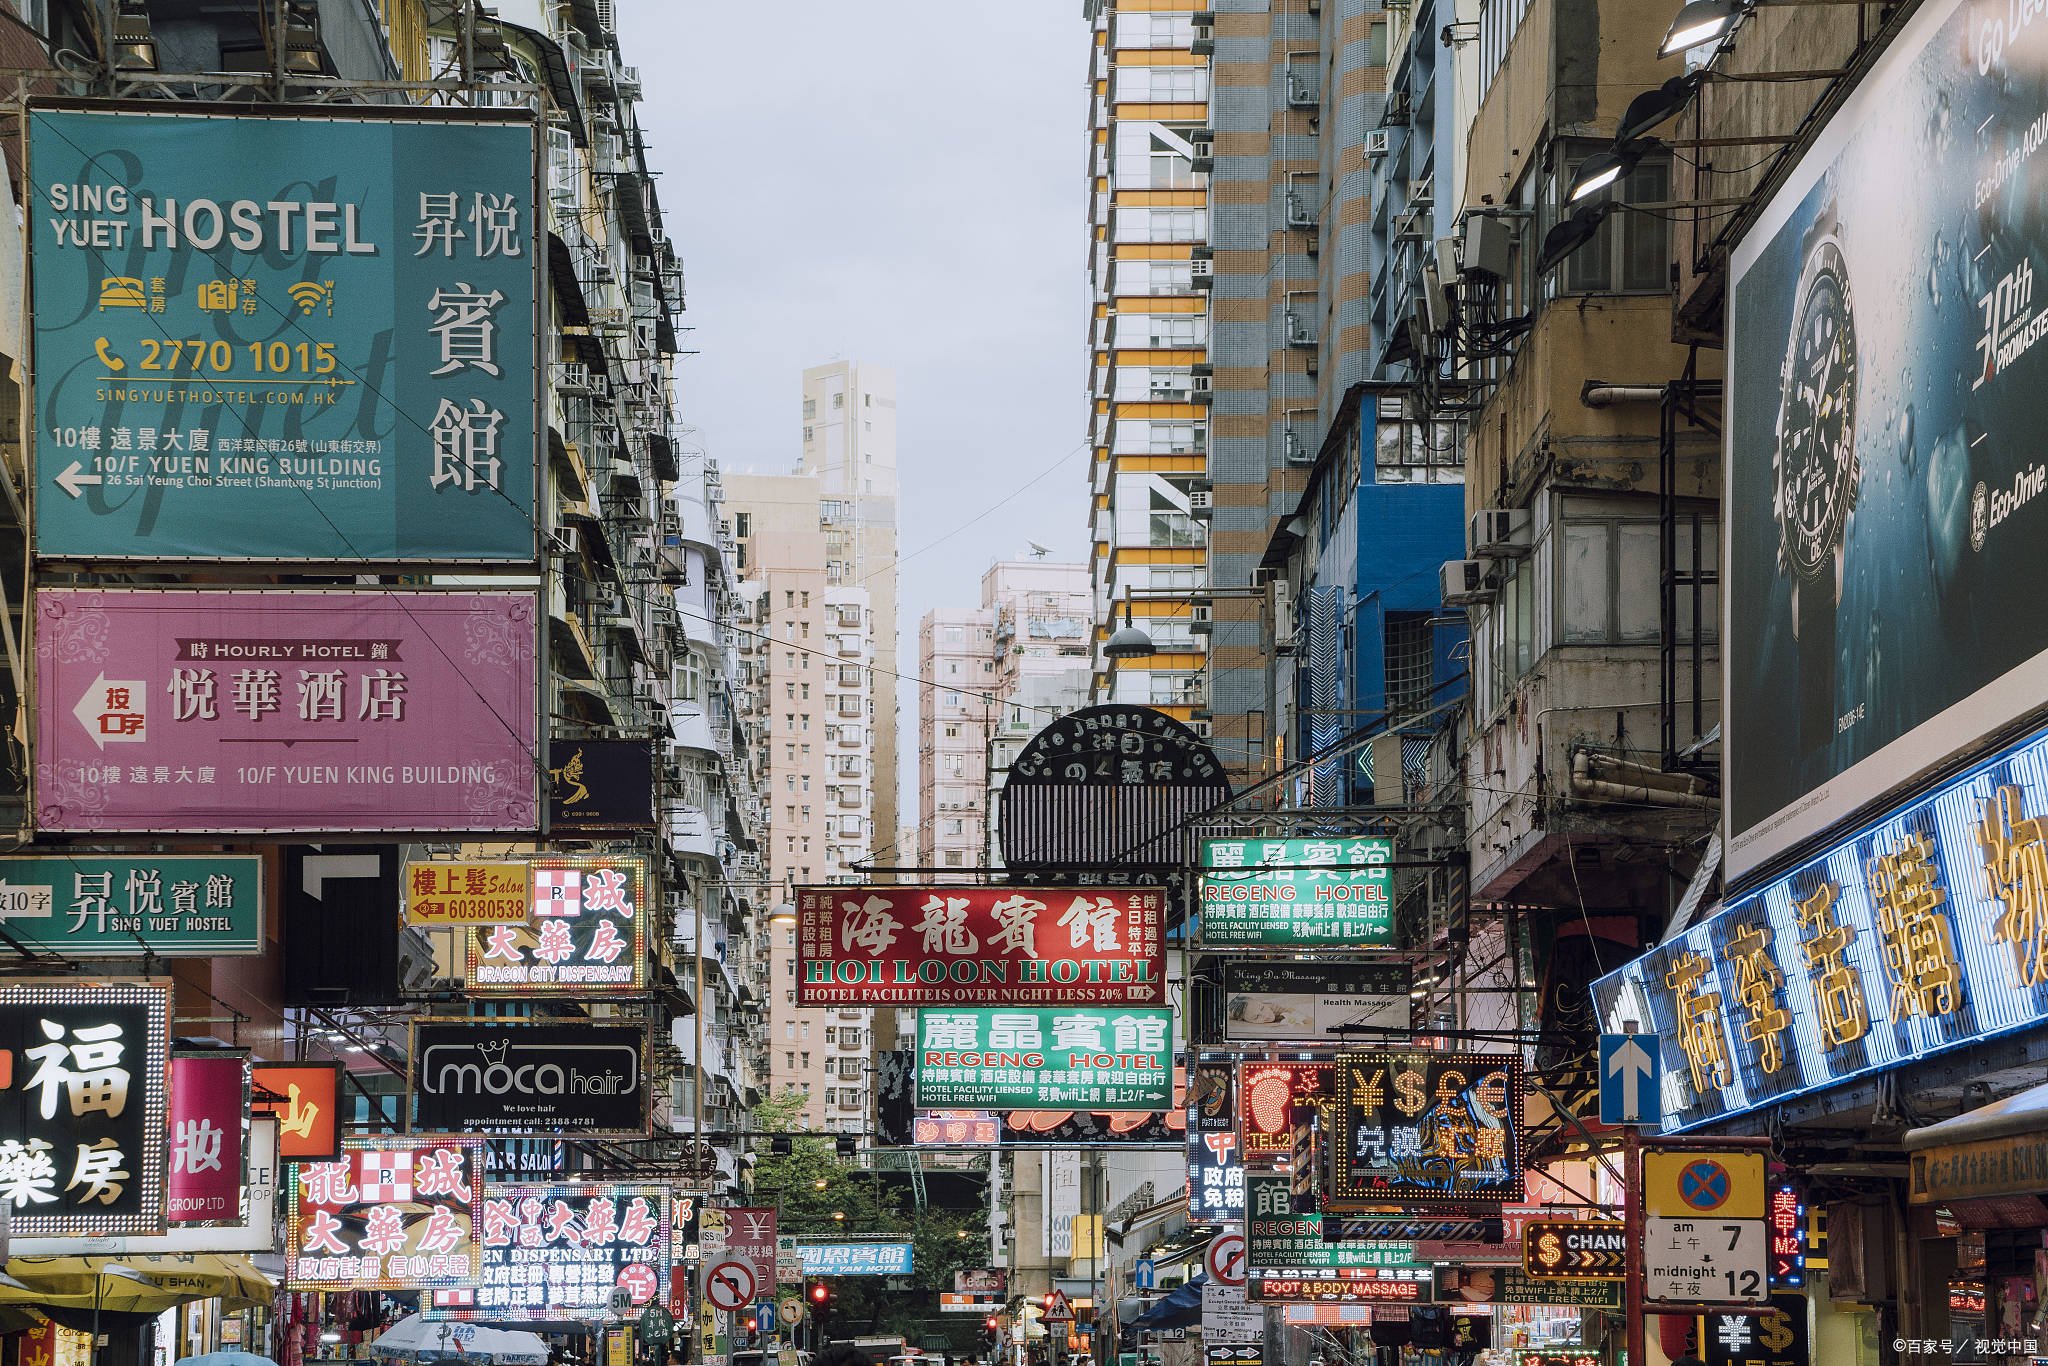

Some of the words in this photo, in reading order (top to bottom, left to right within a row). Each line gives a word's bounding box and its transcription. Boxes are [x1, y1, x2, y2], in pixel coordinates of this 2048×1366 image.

[1978, 17, 2003, 77] Go
[1975, 145, 2019, 210] Eco-Drive
[50, 183, 127, 212] SING
[49, 218, 128, 247] YUET
[142, 198, 375, 253] HOSTEL
[149, 276, 167, 314] 套房
[241, 278, 257, 315] 寄存
[324, 279, 335, 317] WIFI
[140, 339, 232, 372] 2770
[248, 341, 337, 373] 1015
[96, 389, 337, 405] SINGYUETHOSTEL.COM.HK
[52, 426, 102, 451] 10樓
[110, 427, 211, 452] 遠景大廈
[218, 438, 308, 453] 西洋菜南街26號
[94, 457, 139, 473] 10/F
[150, 458, 211, 474] YUEN
[219, 458, 270, 475] KING
[280, 460, 382, 476] BUILDING
[107, 475, 121, 487] 26
[125, 476, 143, 487] Sai
[147, 476, 183, 490] Yeung
[186, 476, 207, 488] Choi
[211, 476, 251, 488] Street
[254, 476, 314, 491] (Shantung
[318, 477, 330, 489] St
[331, 477, 382, 491] junction)
[190, 643, 207, 659] 時
[371, 643, 389, 660] 鐘
[77, 767, 122, 785] 10樓
[129, 766, 217, 785] 遠景大廈
[237, 766, 277, 785] 10/F
[283, 766, 340, 785] YUEN
[347, 766, 395, 785] KING
[402, 766, 496, 785] BUILDING
[413, 868, 487, 897] 樓上髮
[488, 876, 524, 894] Salon
[1205, 884, 1297, 901] REGENG
[1315, 884, 1388, 901] HOTEL
[584, 869, 633, 918] 城
[449, 899, 524, 919] 60380538
[111, 917, 141, 931] SING
[149, 917, 179, 931] YUET
[186, 917, 232, 931] HOSTEL
[802, 894, 816, 957] 酒店設備
[841, 894, 1122, 958] 海龍賓館
[1127, 894, 1142, 956] 全日特平
[1144, 895, 1158, 957] 時租過夜
[1205, 921, 1228, 930] HOTEL
[1229, 921, 1259, 930] FACILITY
[1261, 921, 1289, 930] LIENSED
[483, 919, 627, 963] 大藥房
[1205, 931, 1228, 939] HOTEL
[1229, 931, 1246, 939] FREE
[1247, 931, 1262, 939] WIFI
[476, 965, 528, 983] DRAGON
[530, 965, 556, 983] CITY
[559, 965, 634, 983] DISPENSARY
[804, 958, 885, 984] HOI
[893, 958, 1008, 984] LOON
[1018, 958, 1159, 984] HOTEL
[1280, 971, 1327, 983] Massage
[804, 988, 859, 1001] HOTEL
[861, 988, 951, 1001] FACILITEIS
[953, 988, 999, 1000] OVER
[1001, 988, 1055, 1001] NIGHT
[1057, 988, 1096, 1000] LESS
[1099, 988, 1123, 999] 20%
[1354, 1000, 1393, 1008] Massage
[922, 1014, 1168, 1052] 麗晶賓館
[22, 1018, 131, 1120] 福
[924, 1051, 1045, 1068] REGENG
[1069, 1053, 1165, 1070] HOTEL
[439, 1063, 565, 1095] moca
[570, 1067, 623, 1095] hair
[921, 1069, 977, 1084] 持牌賓館
[980, 1070, 1036, 1085] 酒店設備
[1096, 1070, 1166, 1086] 歡迎自由行
[921, 1086, 951, 1094] HOTEL
[953, 1086, 993, 1094] FACILITY
[995, 1086, 1033, 1095] LIENSED
[921, 1094, 951, 1102] HOTEL
[953, 1094, 976, 1102] FREE
[978, 1094, 997, 1102] WIFI
[538, 1104, 556, 1112] hair
[463, 1117, 522, 1126] appointment
[544, 1117, 571, 1126] 2388
[572, 1117, 595, 1126] 4781
[173, 1119, 224, 1174] 妝
[0, 1137, 130, 1208] 藥房
[416, 1149, 472, 1203] 城
[1203, 1166, 1244, 1187] 政府
[169, 1198, 205, 1212] GROUP
[206, 1197, 225, 1211] LTD
[1773, 1192, 1797, 1236] 美甲
[303, 1205, 466, 1254] 大藥房
[546, 1197, 657, 1246] 大藥房
[1668, 1237, 1701, 1250] 上午
[1673, 1222, 1694, 1232] am
[1722, 1225, 1742, 1251] 7
[1775, 1237, 1799, 1254] M2
[511, 1248, 613, 1262] DISPENSARY
[621, 1248, 659, 1262] LTD.
[298, 1256, 381, 1280] 政府註冊
[388, 1255, 470, 1279] 信心保證
[169, 1277, 205, 1288] SHAN
[1264, 1281, 1301, 1293] FOOT
[1302, 1282, 1311, 1293] &
[1313, 1282, 1350, 1294] BODY
[1352, 1283, 1417, 1295] MASSAGE
[1653, 1266, 1716, 1279] midnight
[1724, 1269, 1760, 1297] 12
[1669, 1281, 1702, 1296] 午夜
[611, 1293, 631, 1308] 5M
[1504, 1294, 1545, 1303] HOTEL
[1549, 1295, 1582, 1303] FREE
[1584, 1296, 1608, 1304] WIFI
[1216, 1329, 1227, 1338] 12
